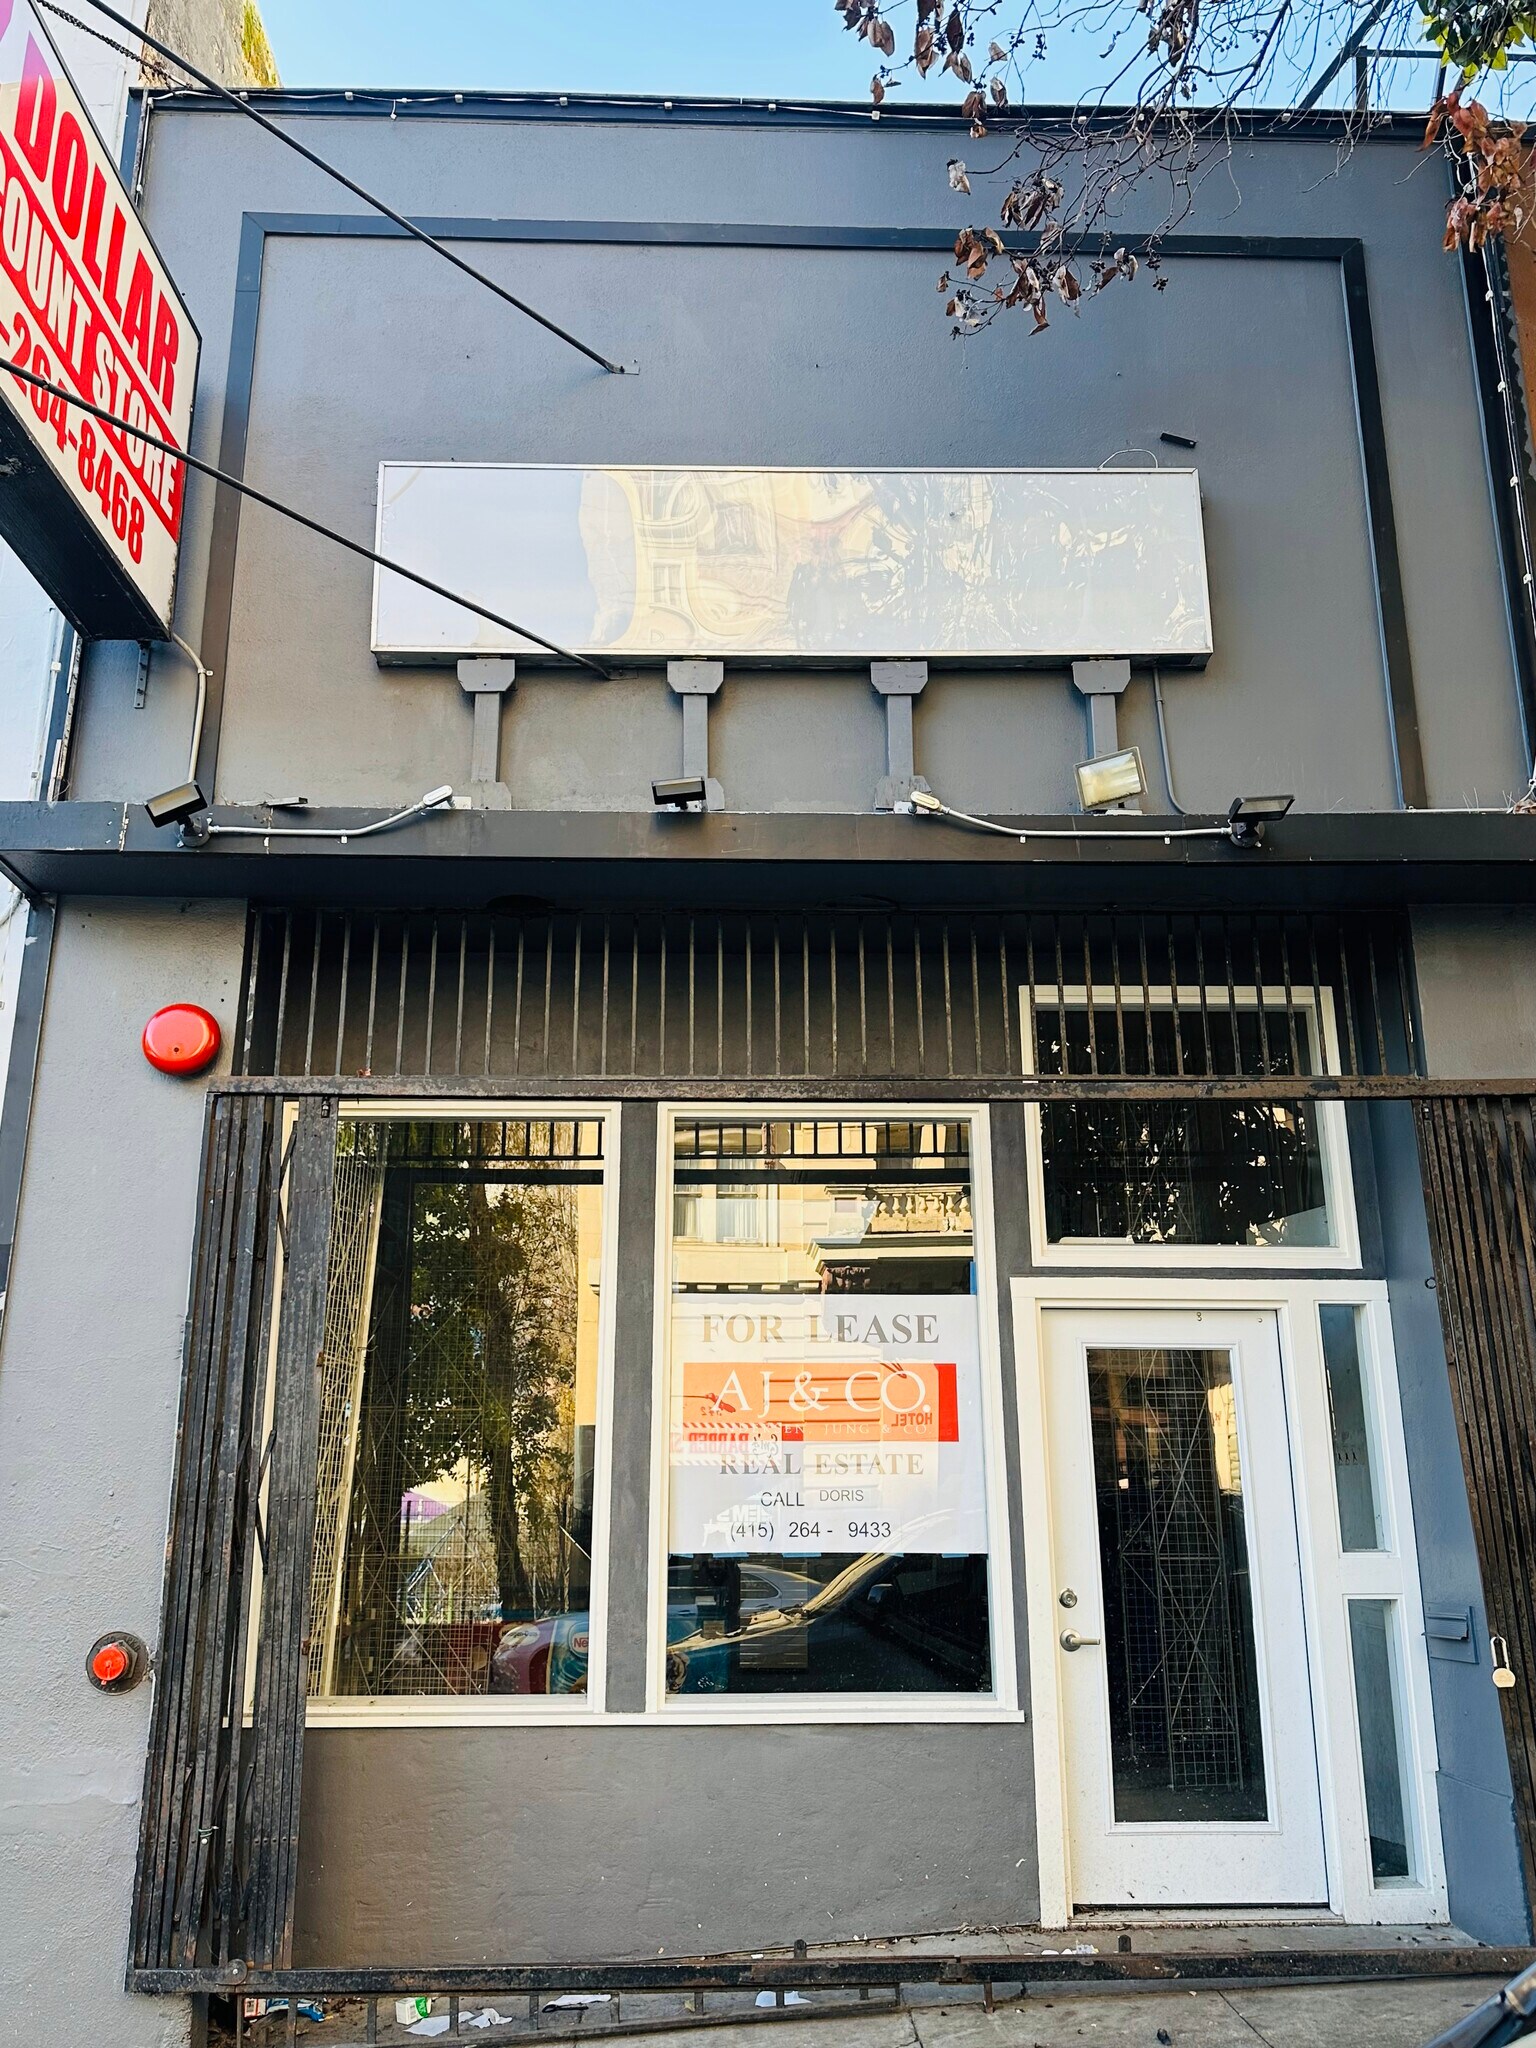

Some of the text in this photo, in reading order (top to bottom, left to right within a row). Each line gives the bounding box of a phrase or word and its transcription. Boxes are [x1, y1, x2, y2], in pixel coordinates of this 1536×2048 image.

[14, 31, 179, 416] DOLLAR
[91, 331, 177, 519] STORE
[702, 1313, 940, 1344] FOR LEASE
[788, 1371, 829, 1412] &
[844, 1370, 931, 1413] CO.
[824, 1423, 870, 1434] JUNG
[719, 1453, 925, 1475] REAL ESTATE
[760, 1490, 864, 1507] CALL DORIS
[730, 1521, 775, 1542] (415)
[788, 1521, 821, 1538] 264
[848, 1521, 892, 1538] 9433
